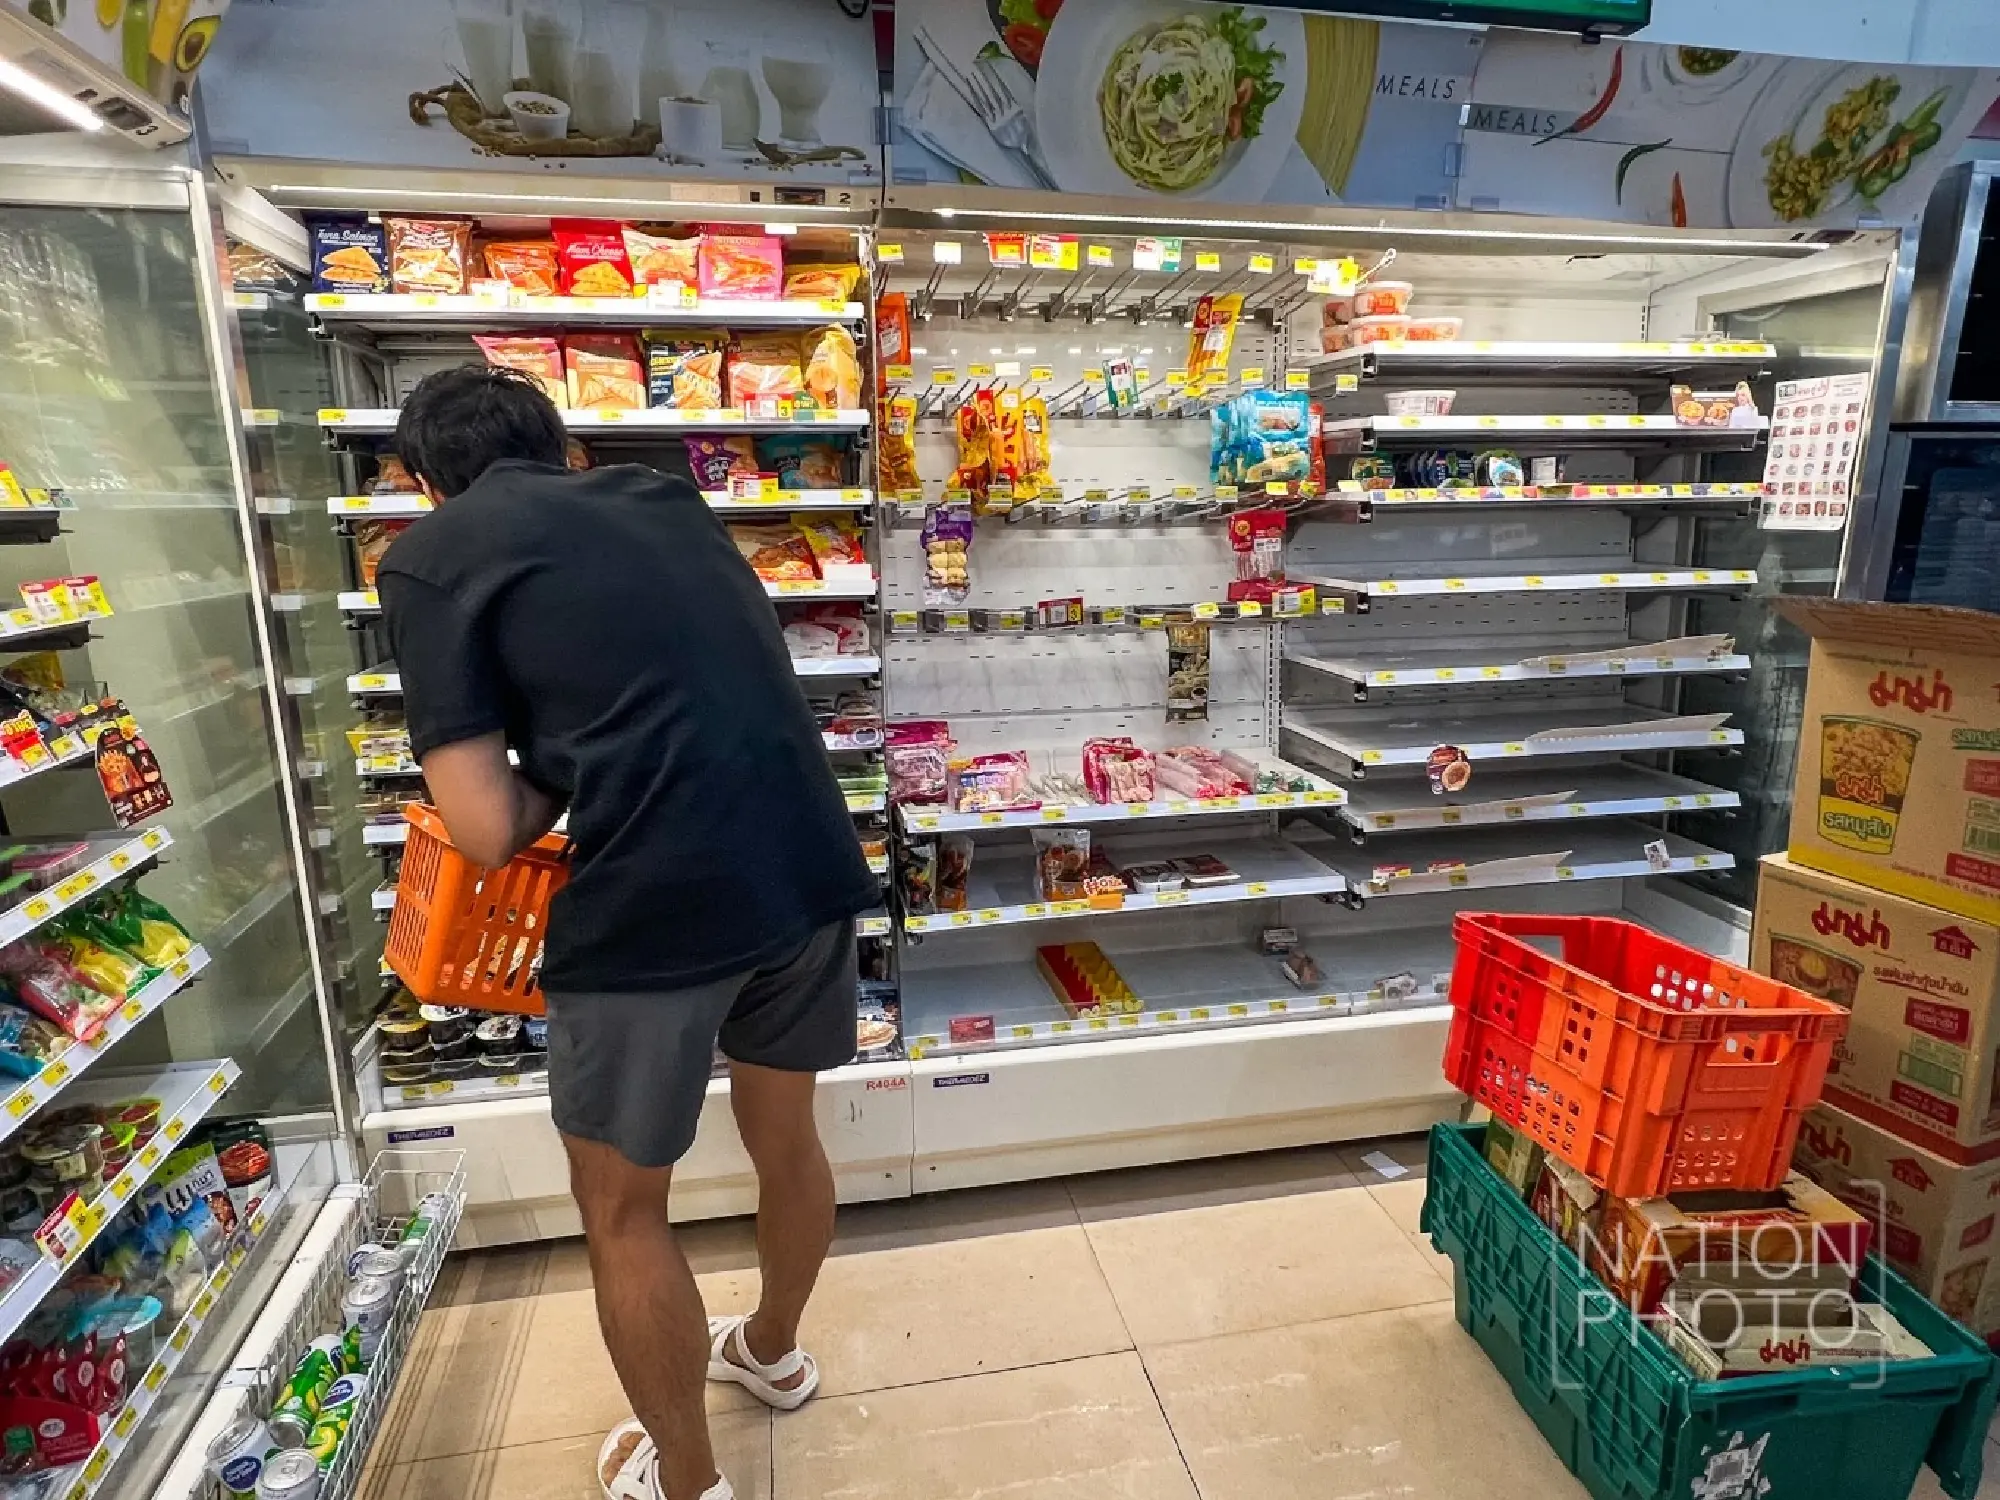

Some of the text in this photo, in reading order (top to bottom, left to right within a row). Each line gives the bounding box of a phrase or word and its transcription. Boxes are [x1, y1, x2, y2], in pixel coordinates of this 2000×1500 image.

[1375, 75, 1457, 100] MEALS
[1472, 107, 1558, 135] MEALS
[839, 192, 851, 204] 2
[341, 229, 379, 243] Salmon
[591, 244, 625, 257] Cheese
[1868, 668, 1953, 714] มาม่า
[1835, 771, 1885, 805] มาม่า
[1823, 811, 1892, 841] รสหมูสับ
[1811, 901, 1891, 950] มาม่า
[866, 1077, 906, 1091] R404A
[1798, 1116, 1852, 1167] าม่า
[1760, 1333, 1811, 1364] มาม่า
